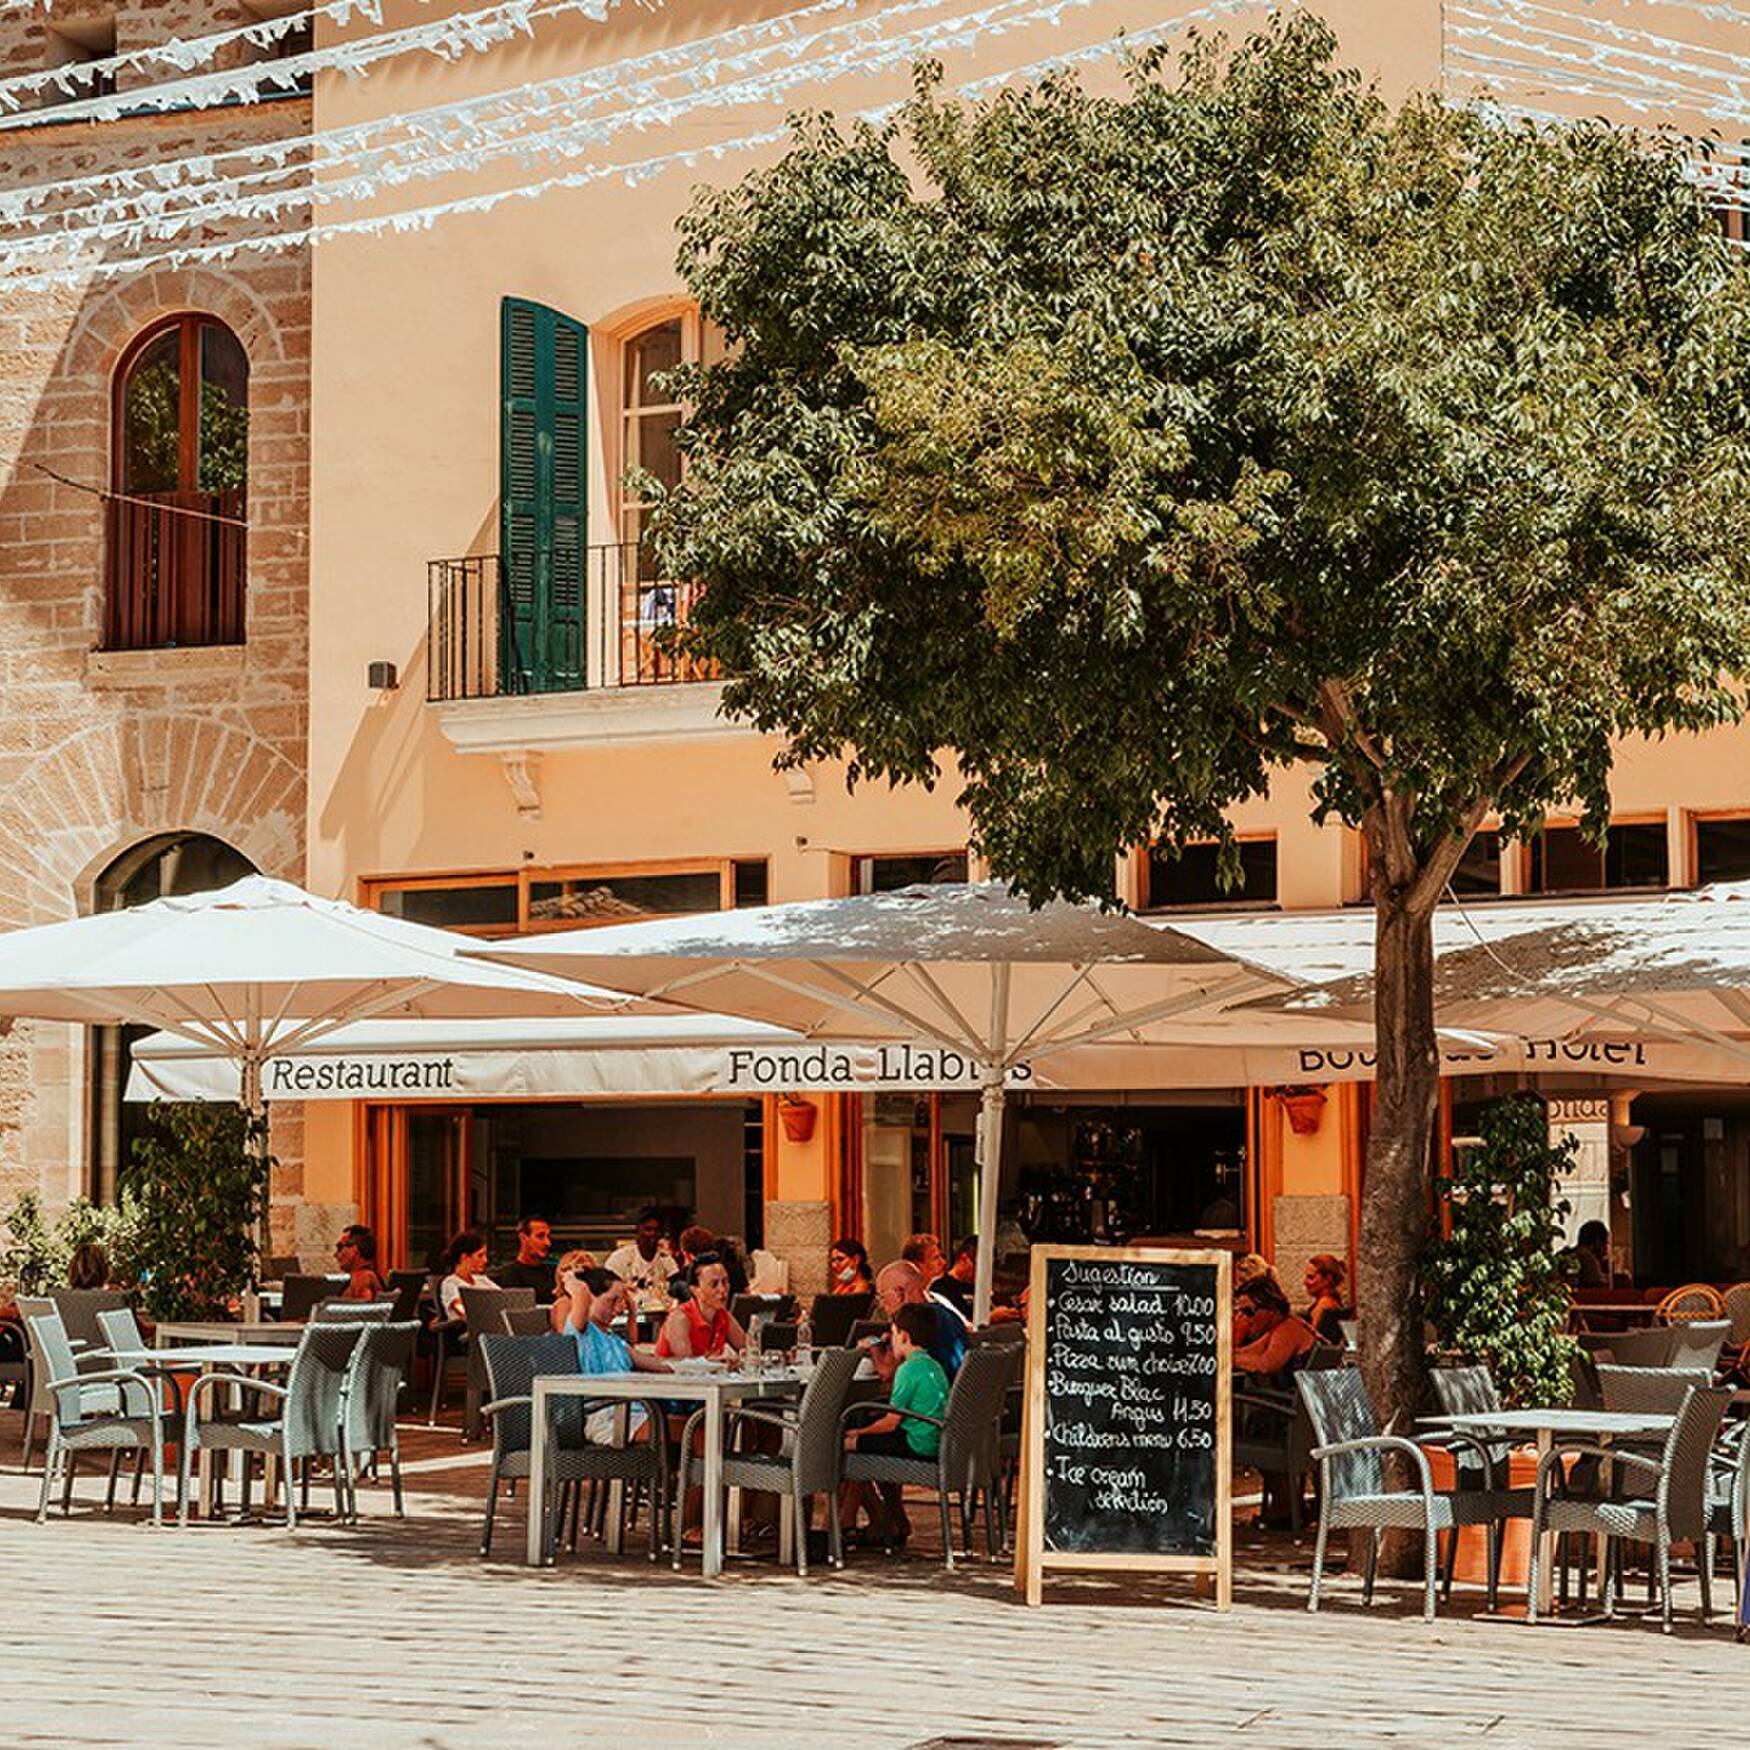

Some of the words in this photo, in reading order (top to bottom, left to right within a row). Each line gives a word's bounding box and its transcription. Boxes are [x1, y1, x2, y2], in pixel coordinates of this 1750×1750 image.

[272, 1057, 453, 1090] Restaurant
[728, 1046, 854, 1084] Fonda
[1108, 1292, 1167, 1315] salad
[1055, 1313, 1101, 1341] Pasta
[1103, 1318, 1126, 1342] al
[1128, 1316, 1175, 1351] gusto
[1051, 1342, 1103, 1370] Pizza
[1111, 1401, 1165, 1432] Angus
[1055, 1455, 1086, 1486] Ice
[1090, 1466, 1147, 1489] cream
